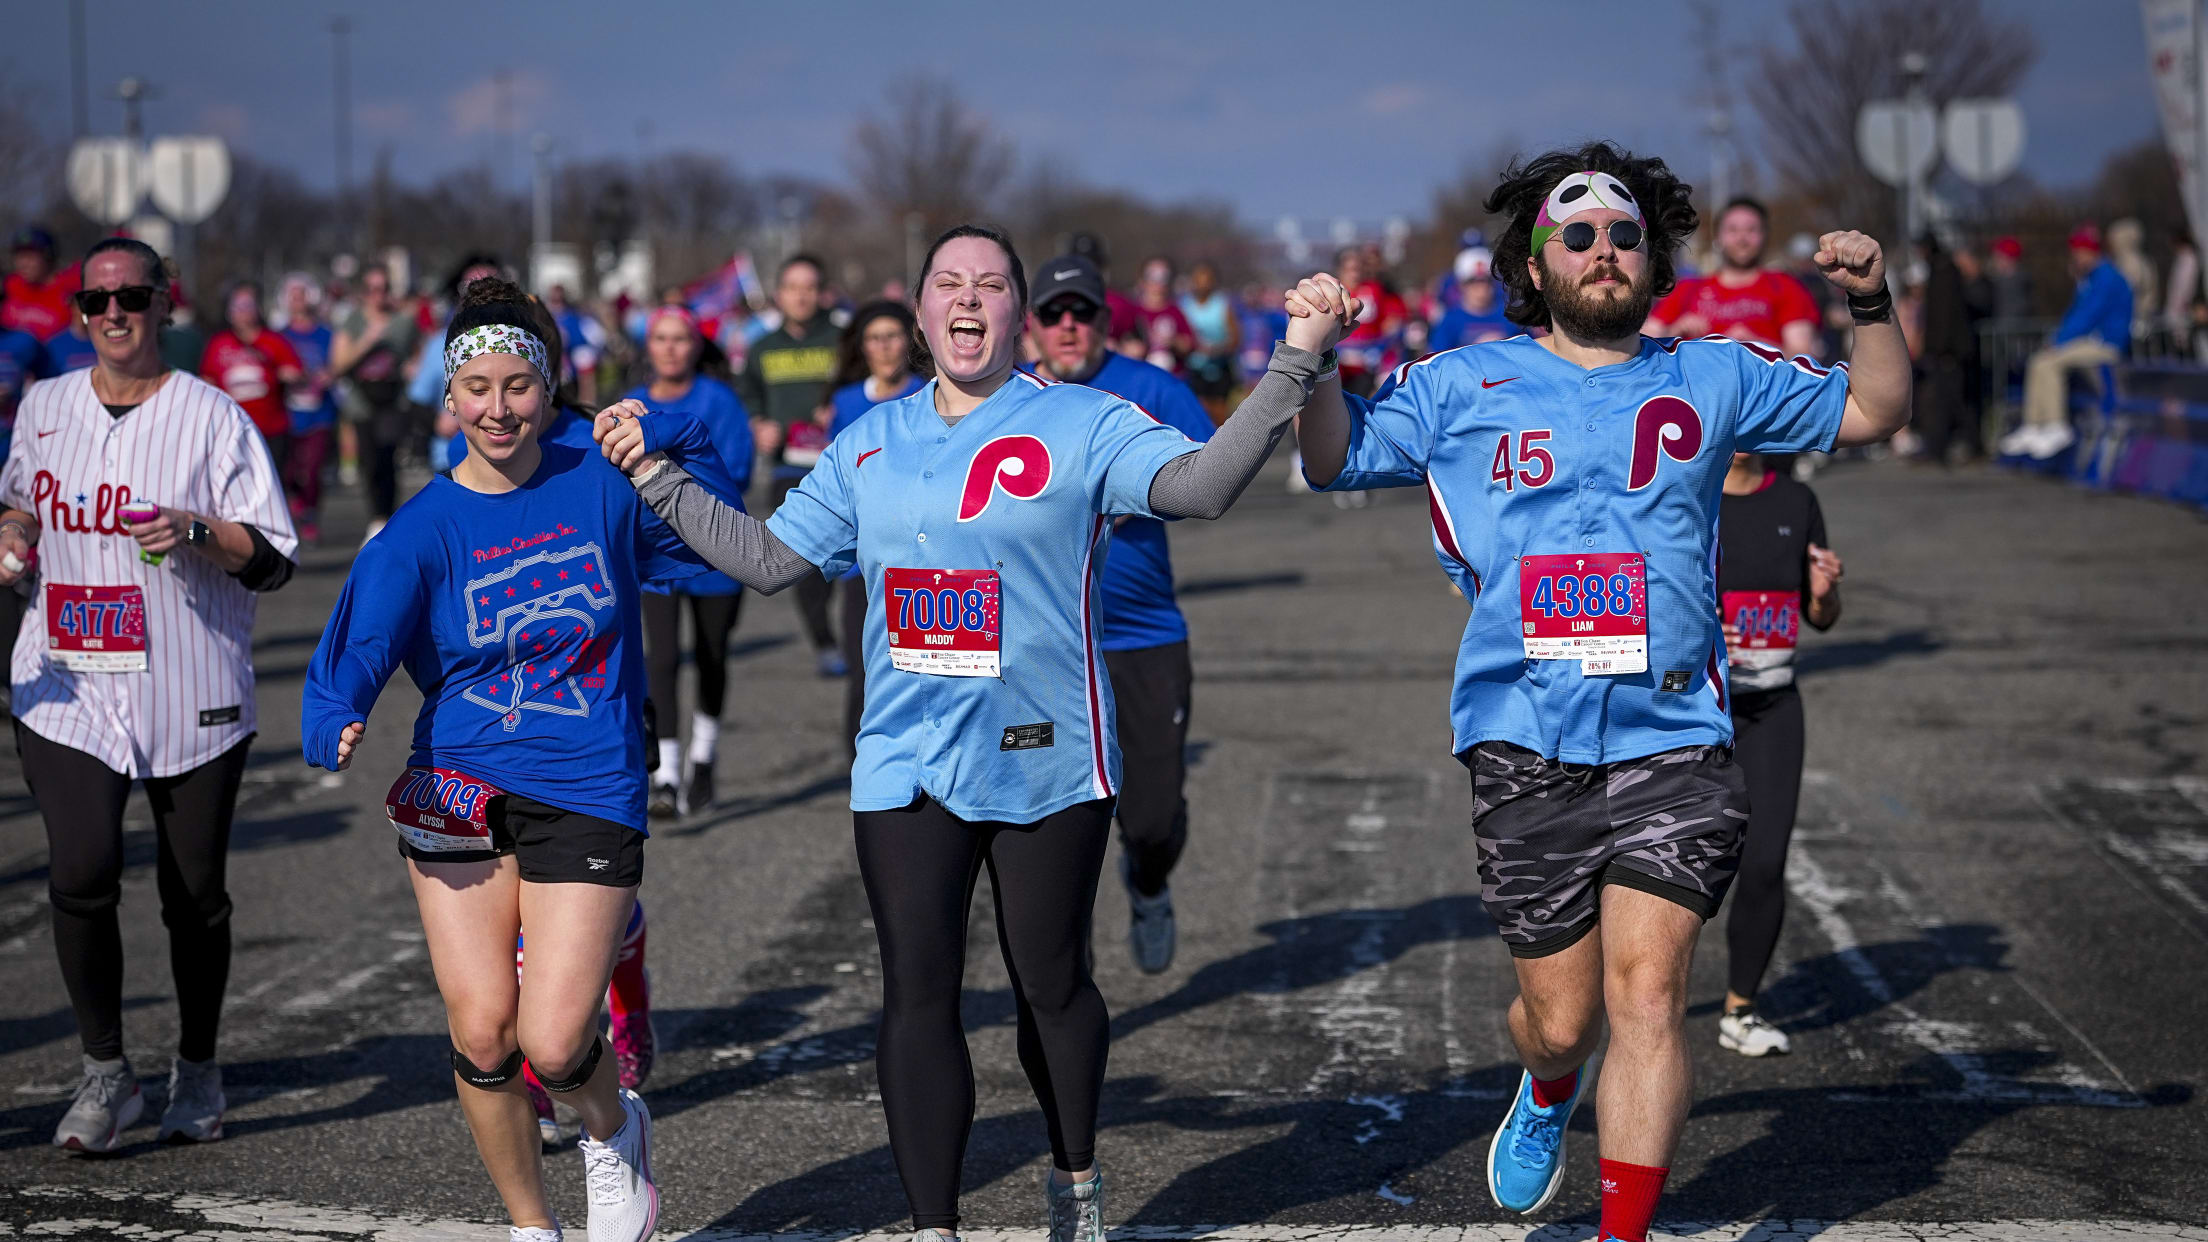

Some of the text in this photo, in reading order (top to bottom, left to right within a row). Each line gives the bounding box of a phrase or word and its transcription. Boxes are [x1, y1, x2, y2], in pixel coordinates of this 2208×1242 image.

[1491, 428, 1556, 494] 45
[1627, 395, 1703, 491] P
[957, 434, 1053, 522] P
[31, 469, 133, 537] Phill
[473, 523, 578, 564] Phillies Charities Inc.
[894, 588, 985, 631] 7008
[1532, 573, 1632, 618] 4388
[58, 600, 128, 637] 4177
[924, 634, 955, 645] MADDY
[1571, 621, 1594, 632] LIAM
[399, 769, 482, 820] 7009
[418, 813, 446, 829] ALYSSA
